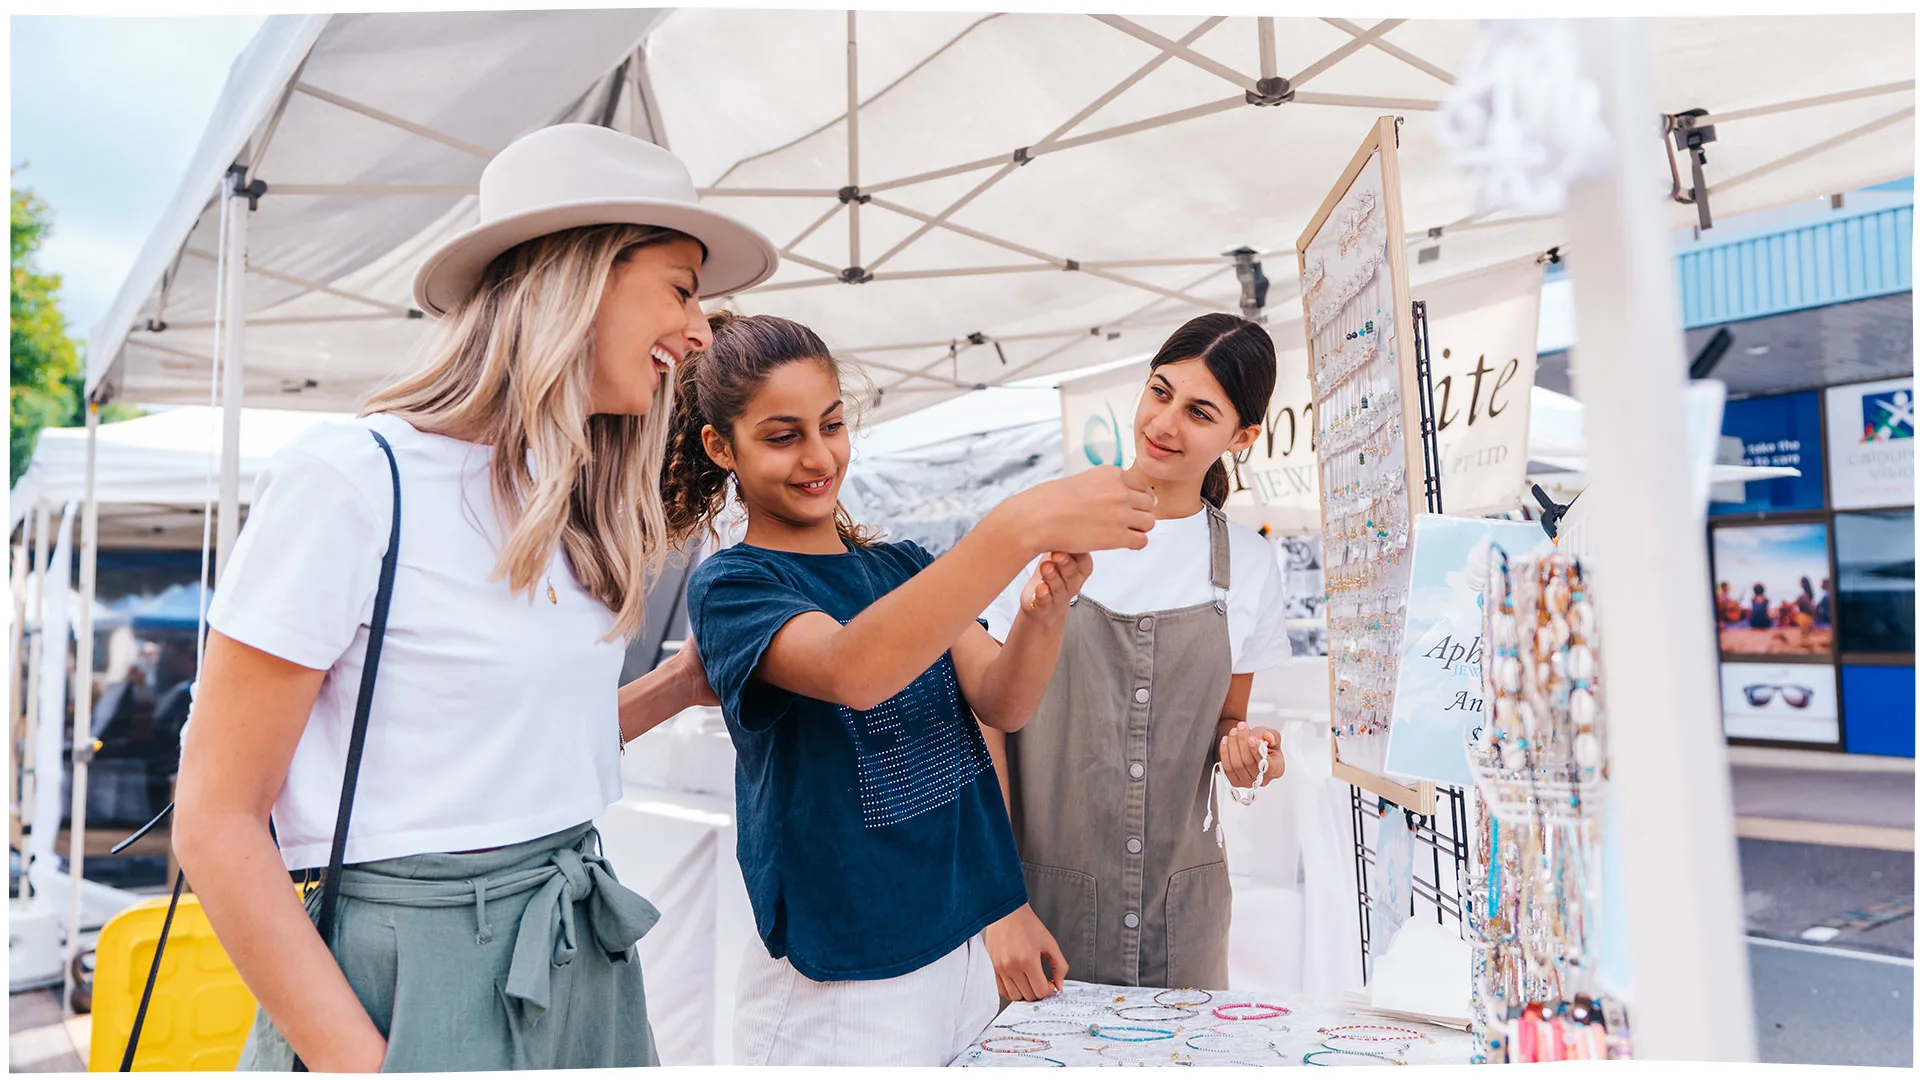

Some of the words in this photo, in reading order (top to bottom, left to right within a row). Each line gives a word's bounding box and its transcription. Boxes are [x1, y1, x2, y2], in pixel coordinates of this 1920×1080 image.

[1421, 634, 1482, 671] Aph
[1452, 664, 1481, 678] JEW
[1444, 690, 1483, 713] An
